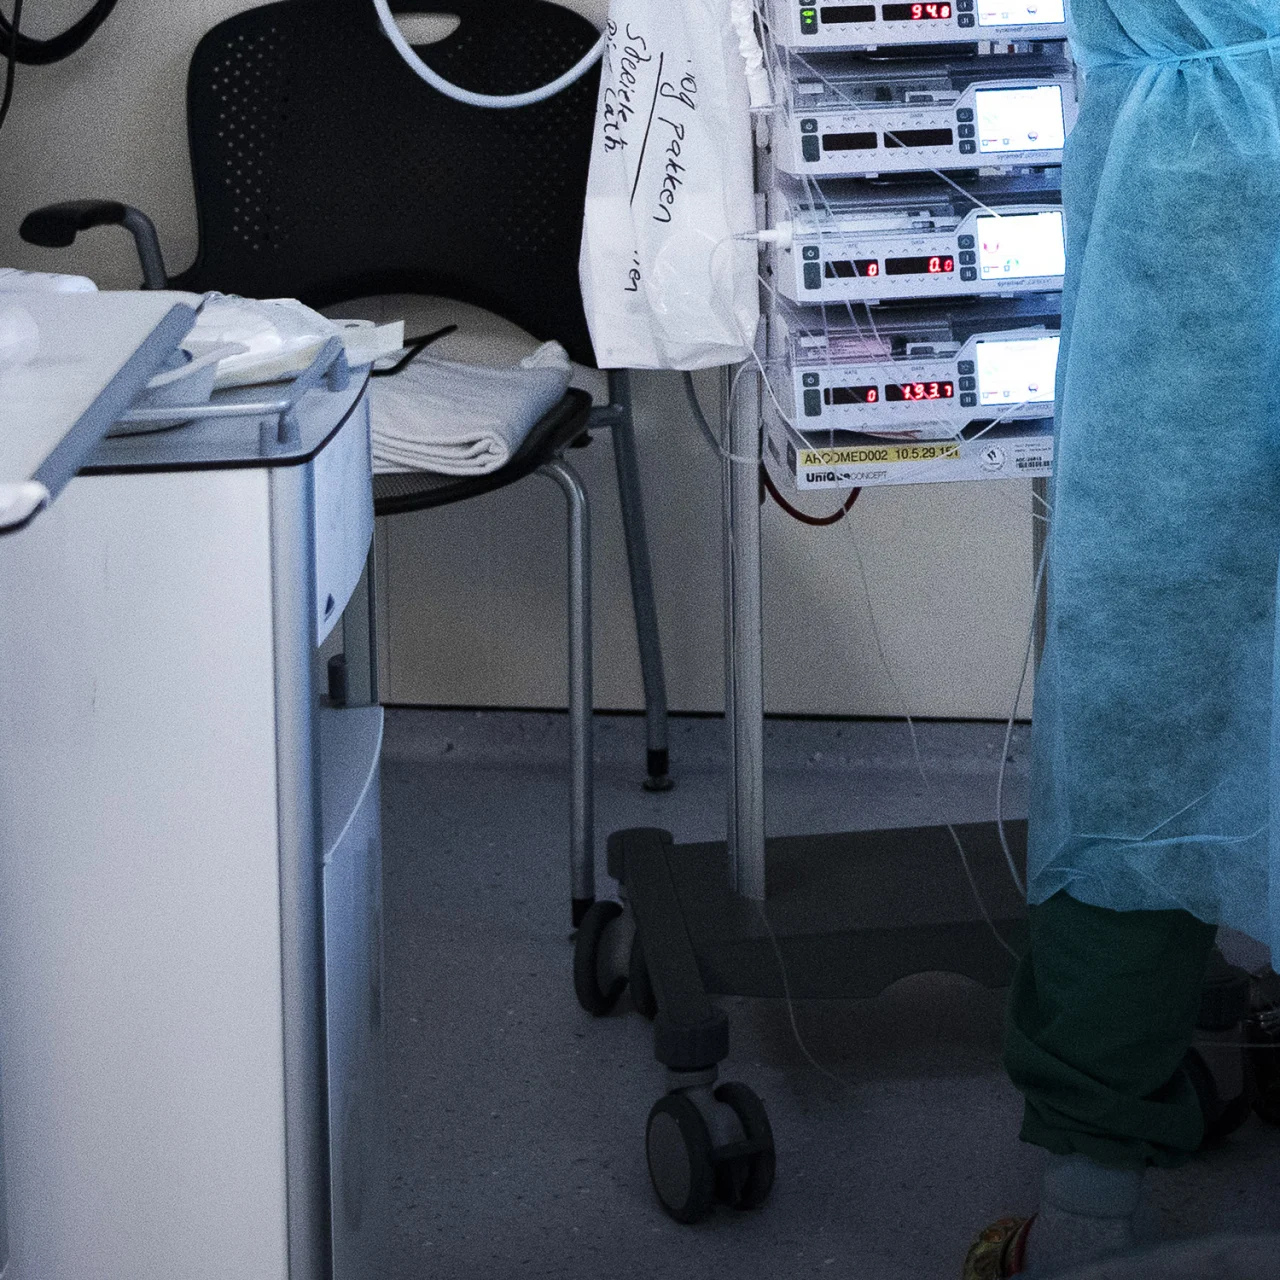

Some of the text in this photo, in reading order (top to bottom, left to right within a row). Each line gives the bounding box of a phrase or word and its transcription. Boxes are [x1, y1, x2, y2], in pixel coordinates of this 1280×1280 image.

[911, 4, 950, 19] 94.8
[652, 117, 687, 223] pakken
[867, 264, 878, 276] 0
[866, 389, 877, 403] 0
